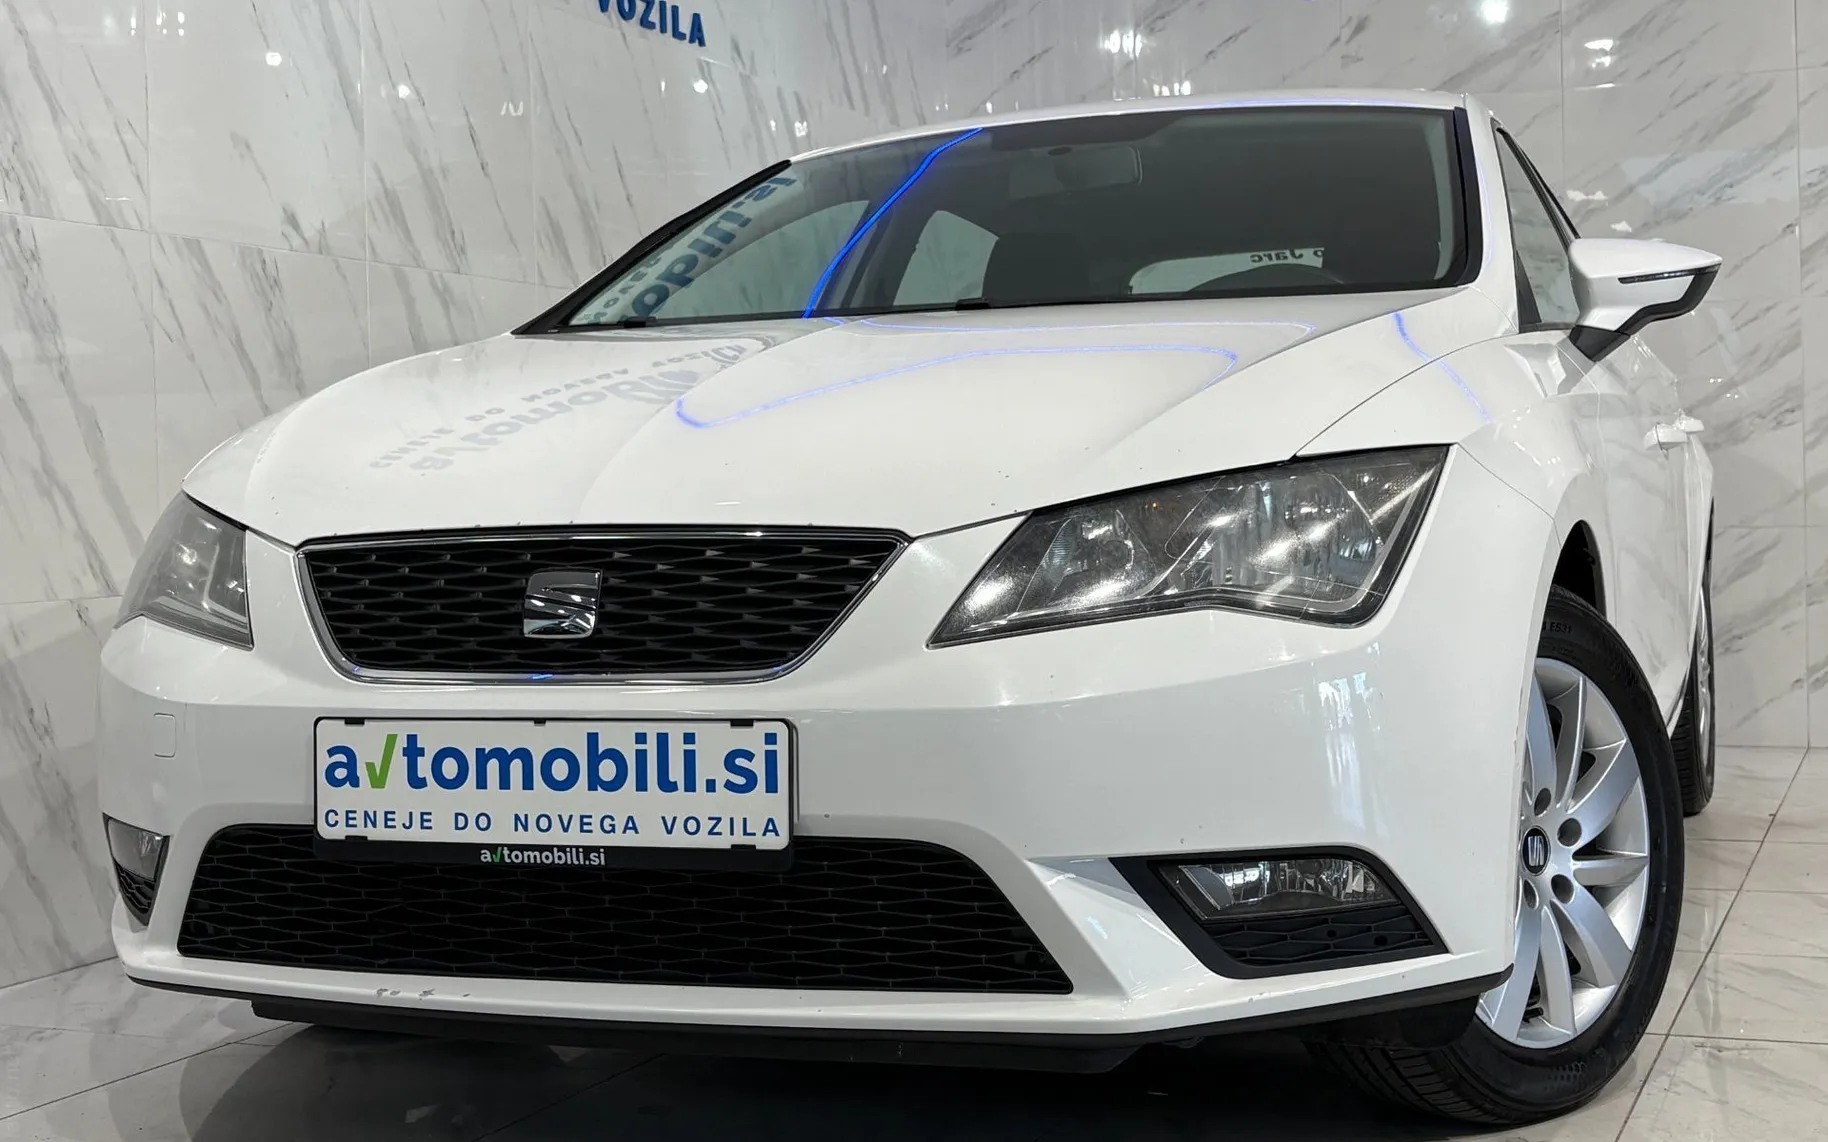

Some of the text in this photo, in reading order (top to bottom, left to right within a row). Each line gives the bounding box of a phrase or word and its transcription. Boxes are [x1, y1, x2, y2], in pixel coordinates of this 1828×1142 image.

[324, 731, 780, 795] avtomobili.si
[324, 808, 781, 838] CENEJE DO NOVEGA VOZILA
[480, 846, 606, 866] avtomobili.si
